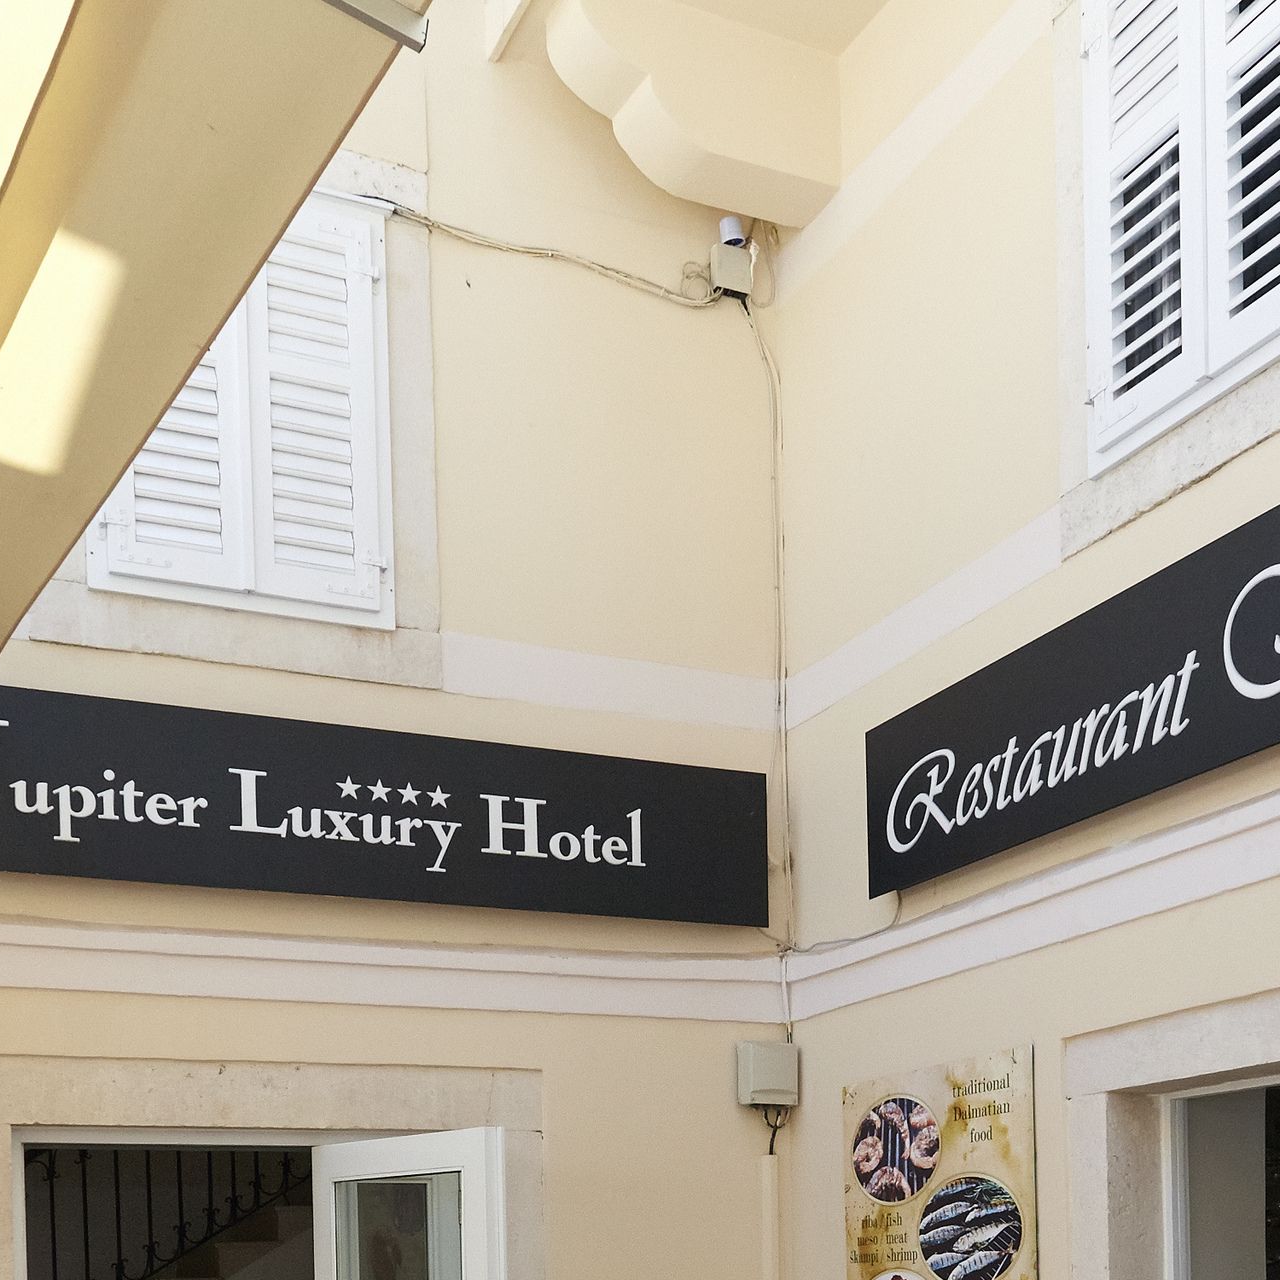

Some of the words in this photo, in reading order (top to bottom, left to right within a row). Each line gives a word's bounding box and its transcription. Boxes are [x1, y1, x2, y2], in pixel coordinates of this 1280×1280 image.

[885, 649, 1200, 854] Restaurant
[228, 767, 463, 873] Luxury
[479, 793, 647, 867] Hotel
[952, 1073, 1011, 1099] traditional
[952, 1101, 1011, 1122] Dalmatian
[969, 1126, 994, 1143] food
[886, 1212, 903, 1227] fish
[886, 1232, 908, 1245] meat
[886, 1247, 918, 1264] shrimp
